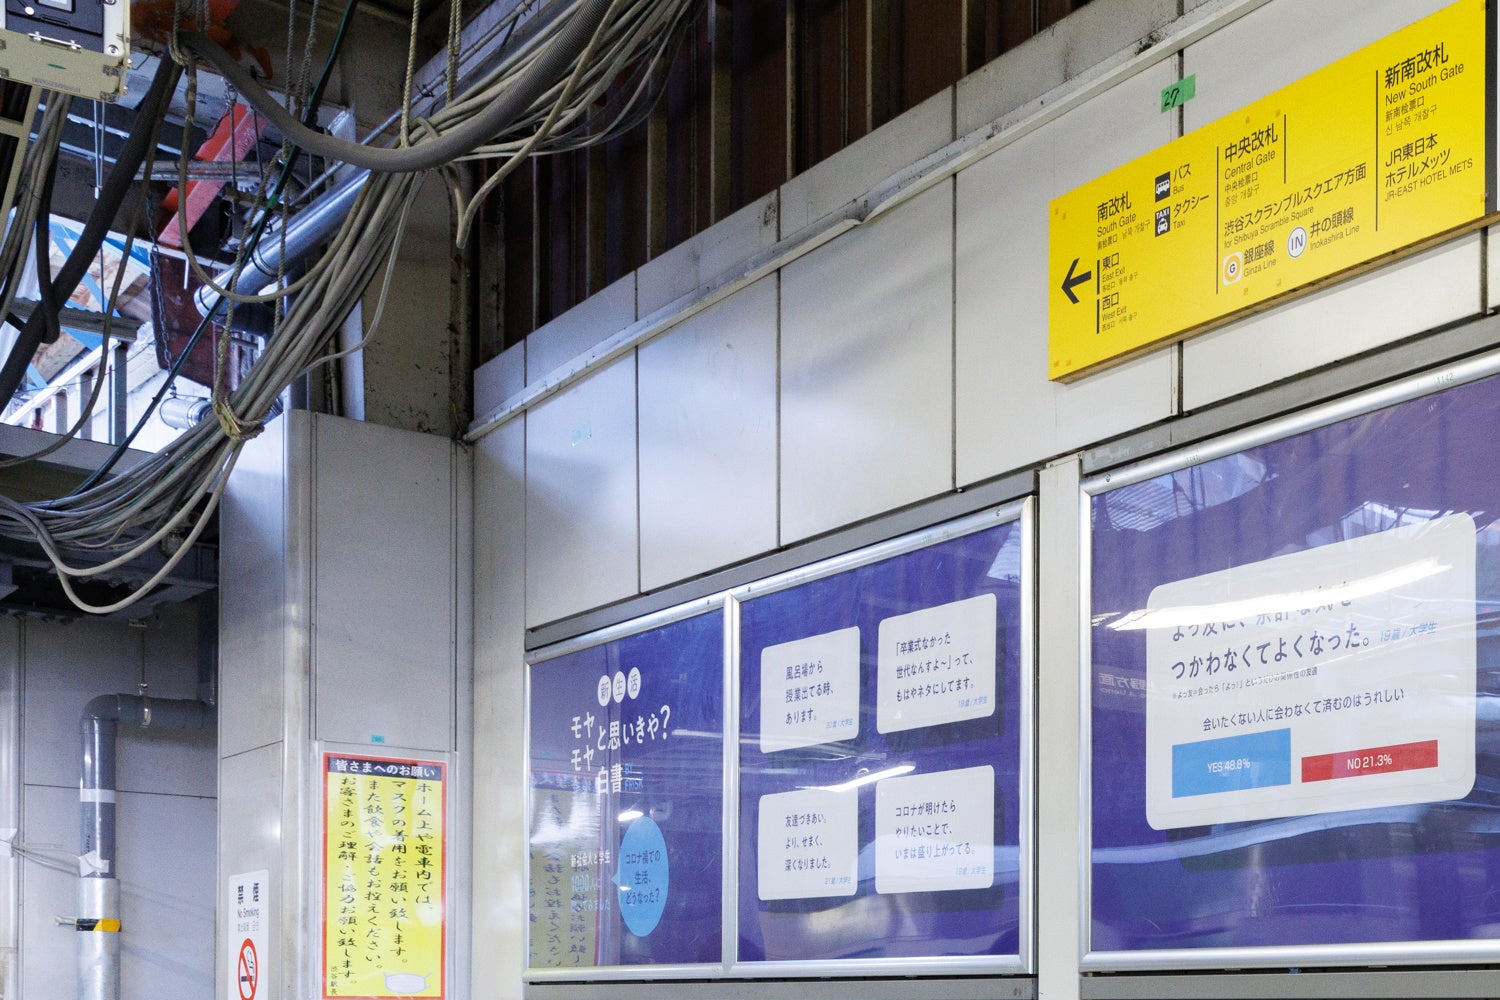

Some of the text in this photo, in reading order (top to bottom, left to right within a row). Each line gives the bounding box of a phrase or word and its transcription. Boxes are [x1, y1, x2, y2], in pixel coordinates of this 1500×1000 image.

[1385, 42, 1448, 89] 新南改札
[1386, 63, 1464, 106] New South Gate
[1225, 123, 1278, 163] 中央改札
[1386, 132, 1438, 167] JR東日本
[1174, 164, 1191, 182] バス
[1225, 151, 1275, 180] Central Gate
[1386, 148, 1450, 187] ホテルメッツ
[1173, 185, 1184, 194] Bus
[1385, 158, 1472, 201] JR-EAST HOTEL METS
[1098, 191, 1131, 222] 南改札
[1156, 206, 1169, 219] TAXI
[1174, 195, 1209, 217] タクシー
[1225, 162, 1366, 237] 渋谷スクランブルスクエア方面
[1097, 212, 1136, 238] South Gate
[1173, 220, 1185, 229] Taxi
[1224, 206, 1313, 248] for Shibuya Scramble Square
[1311, 206, 1353, 238] 井の頭線
[1292, 234, 1303, 251] IN
[1310, 225, 1359, 250] Inokashira Line
[1103, 253, 1119, 271] 東口
[1244, 240, 1274, 265] 銀座線
[1103, 272, 1114, 282] East
[1116, 267, 1125, 276] Exit
[1229, 263, 1235, 273] G
[1244, 259, 1276, 277] Ginza Line
[1102, 311, 1115, 321] West
[1117, 306, 1126, 316] Exit
[1103, 292, 1119, 310] 西口
[1172, 622, 1369, 680] つかわなくてよくなった。
[1203, 688, 1404, 731] 会いたくない人に会わなくて済むのはうれしい
[571, 712, 595, 739] モヤ
[598, 705, 670, 751] と思いきや?
[336, 759, 434, 778] 皆さまへのお願い
[571, 745, 594, 771] モヤ
[1207, 758, 1250, 773] YES 48.8%
[1347, 754, 1392, 769] NO 21.3%
[598, 763, 623, 794] 白書
[415, 783, 433, 910] ホーム上や電車内では、
